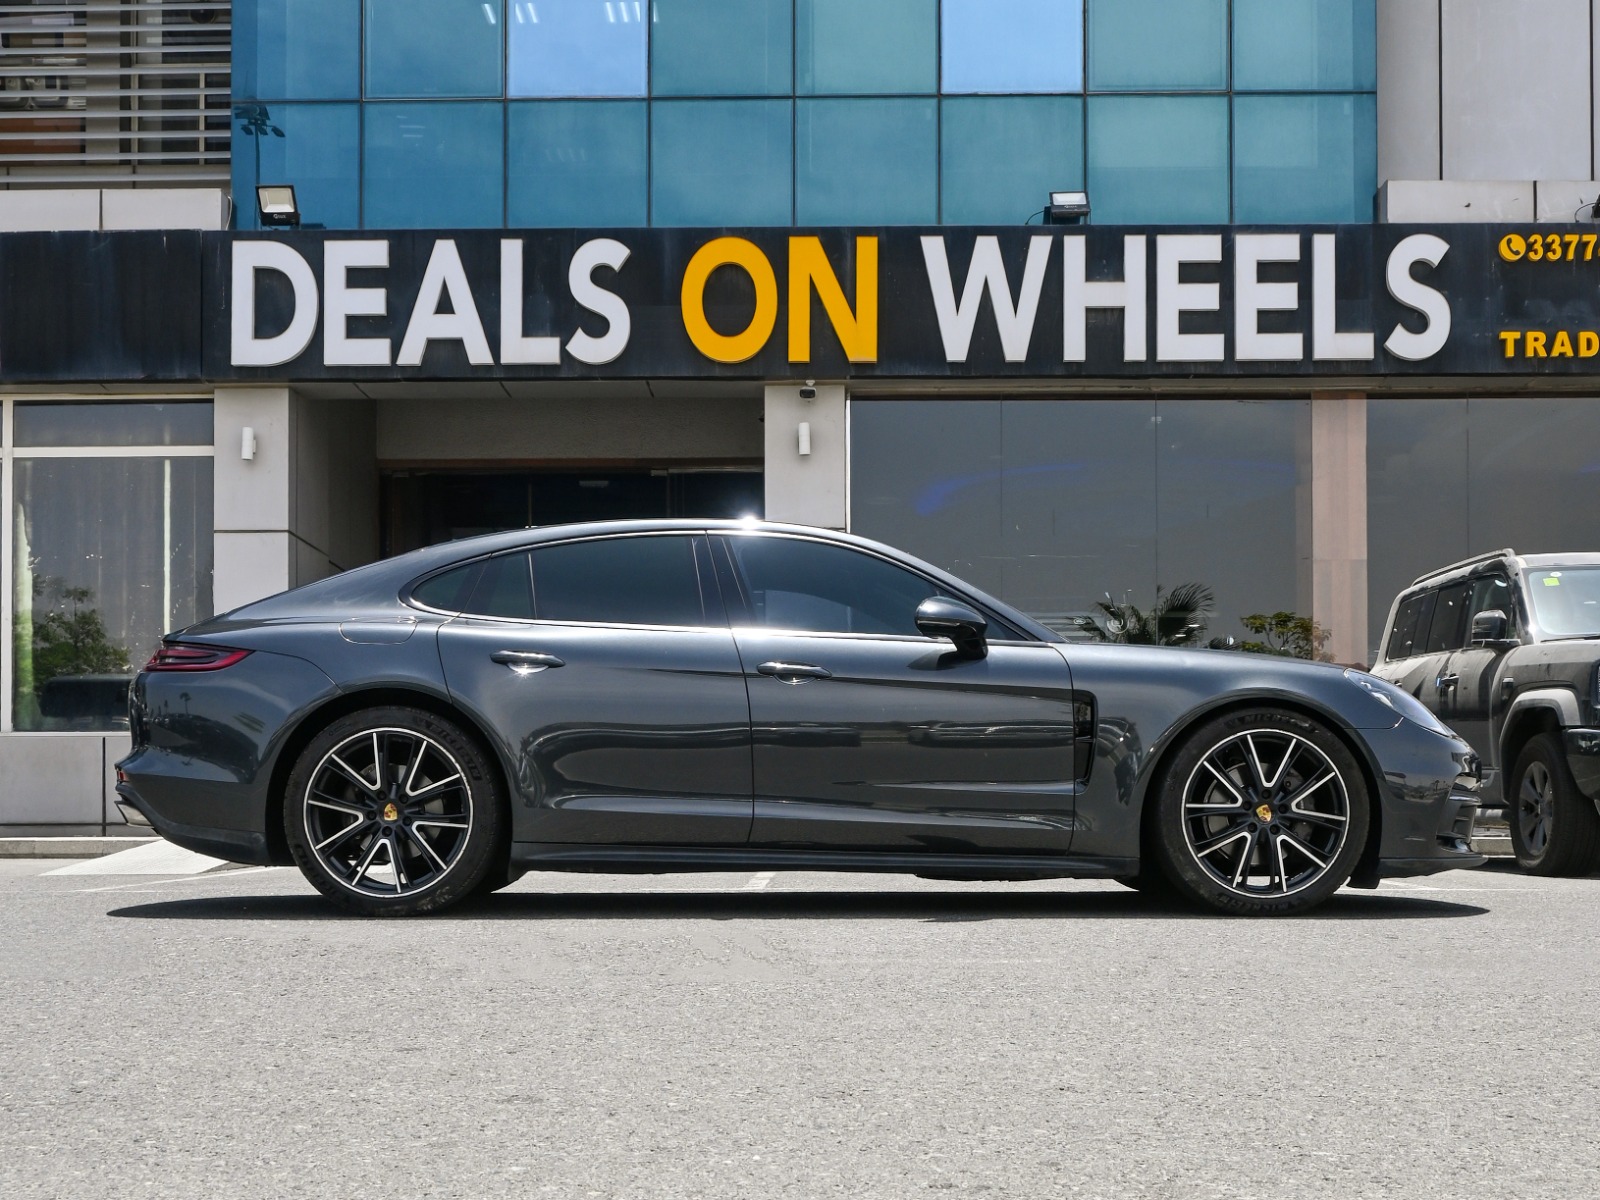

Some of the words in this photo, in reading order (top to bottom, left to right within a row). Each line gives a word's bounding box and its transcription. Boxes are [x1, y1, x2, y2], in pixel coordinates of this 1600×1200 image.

[1526, 233, 1600, 262] 3377
[230, 238, 632, 367] DEALS
[681, 235, 879, 362] ON
[920, 233, 1452, 363] WHEELS
[1498, 330, 1600, 358] TRAD
